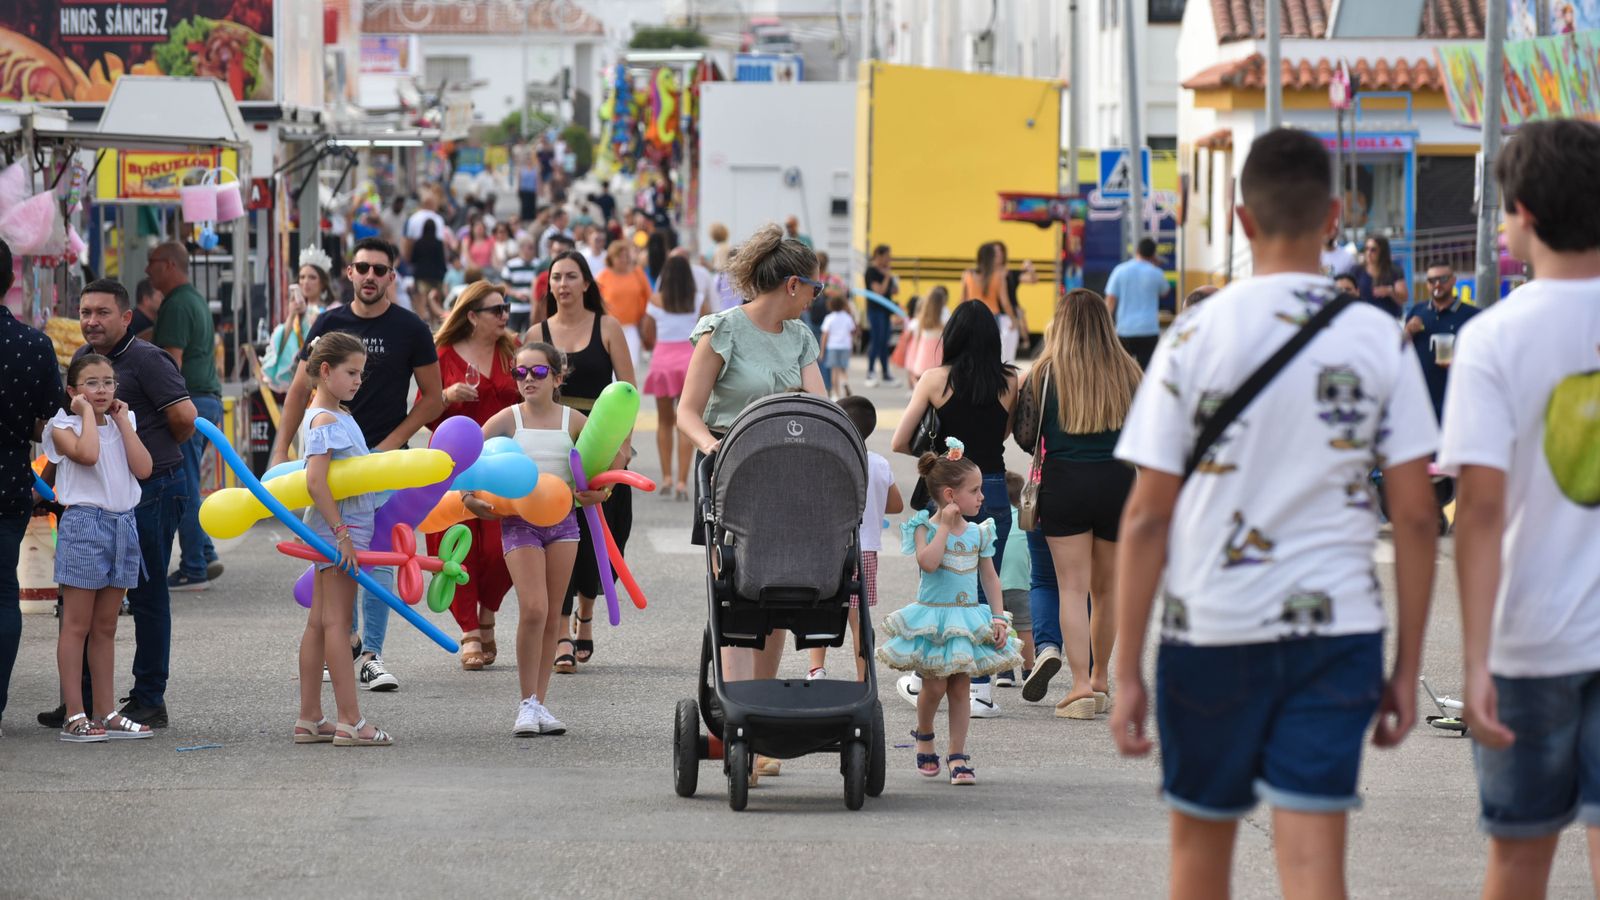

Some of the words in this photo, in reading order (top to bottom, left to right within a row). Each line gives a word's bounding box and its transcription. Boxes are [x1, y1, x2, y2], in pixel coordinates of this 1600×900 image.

[60, 7, 101, 35] HNOS.
[105, 2, 168, 35] SÁNCHEZ
[127, 158, 211, 177] BUÑUELOS
[362, 337, 384, 345] MMY
[367, 345, 385, 353] GER
[250, 422, 269, 440] HEZ
